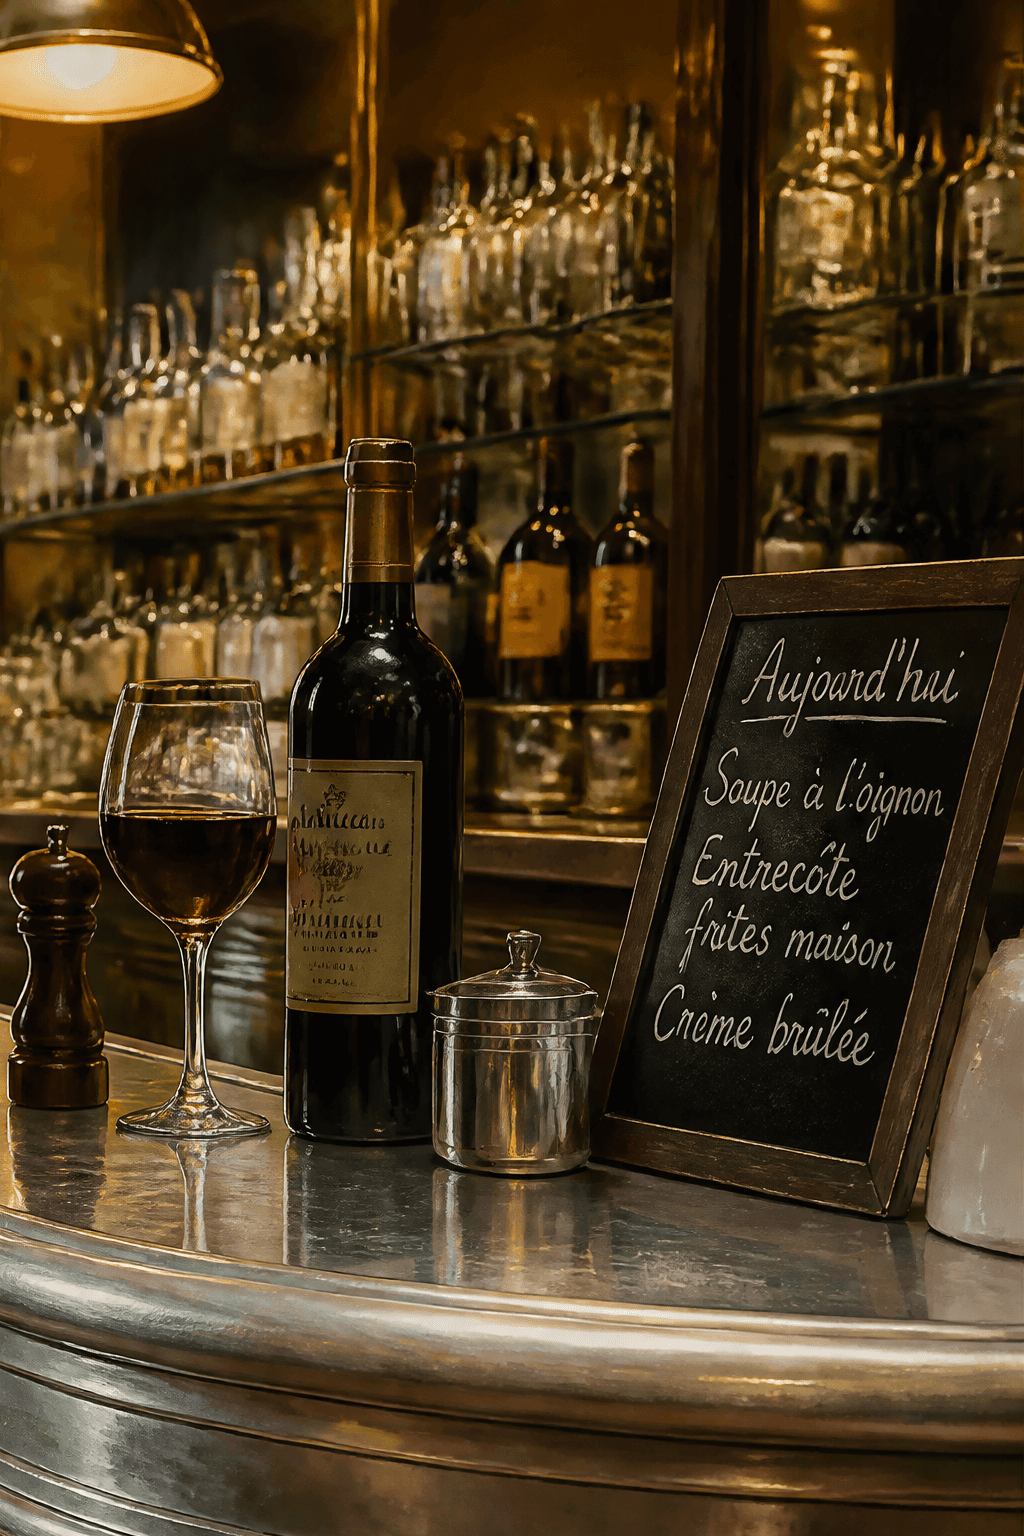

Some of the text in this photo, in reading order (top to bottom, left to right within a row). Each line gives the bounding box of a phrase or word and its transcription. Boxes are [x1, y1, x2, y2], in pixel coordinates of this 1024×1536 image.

[703, 747, 944, 843] Soupe à l'oignon
[692, 834, 859, 900] Entrecôte
[679, 897, 895, 973] frites maison
[767, 992, 875, 1066] brûlée
